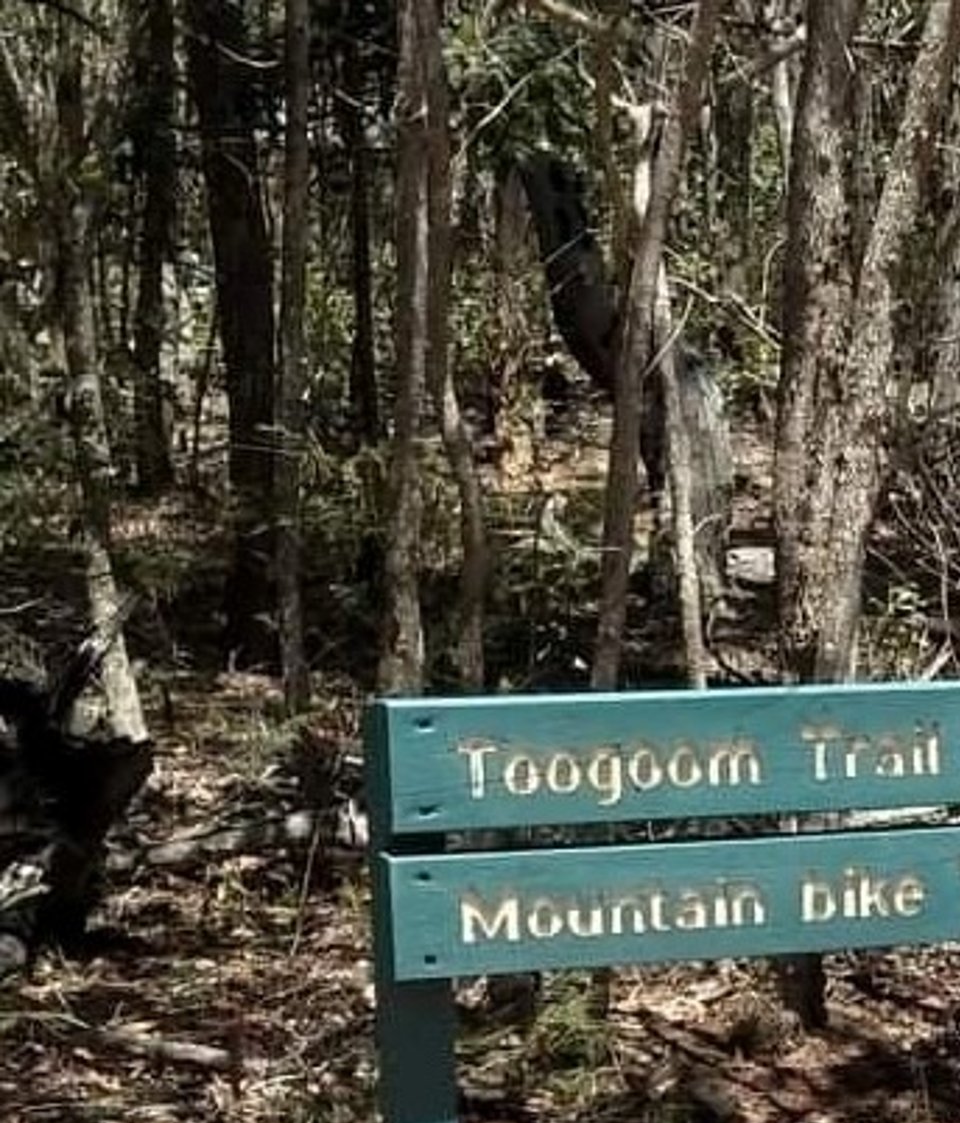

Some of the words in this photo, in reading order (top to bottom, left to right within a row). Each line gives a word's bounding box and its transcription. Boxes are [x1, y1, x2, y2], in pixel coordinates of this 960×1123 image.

[457, 735, 762, 806] Toogoom
[802, 723, 941, 782] Trail
[459, 876, 766, 943] Mountain
